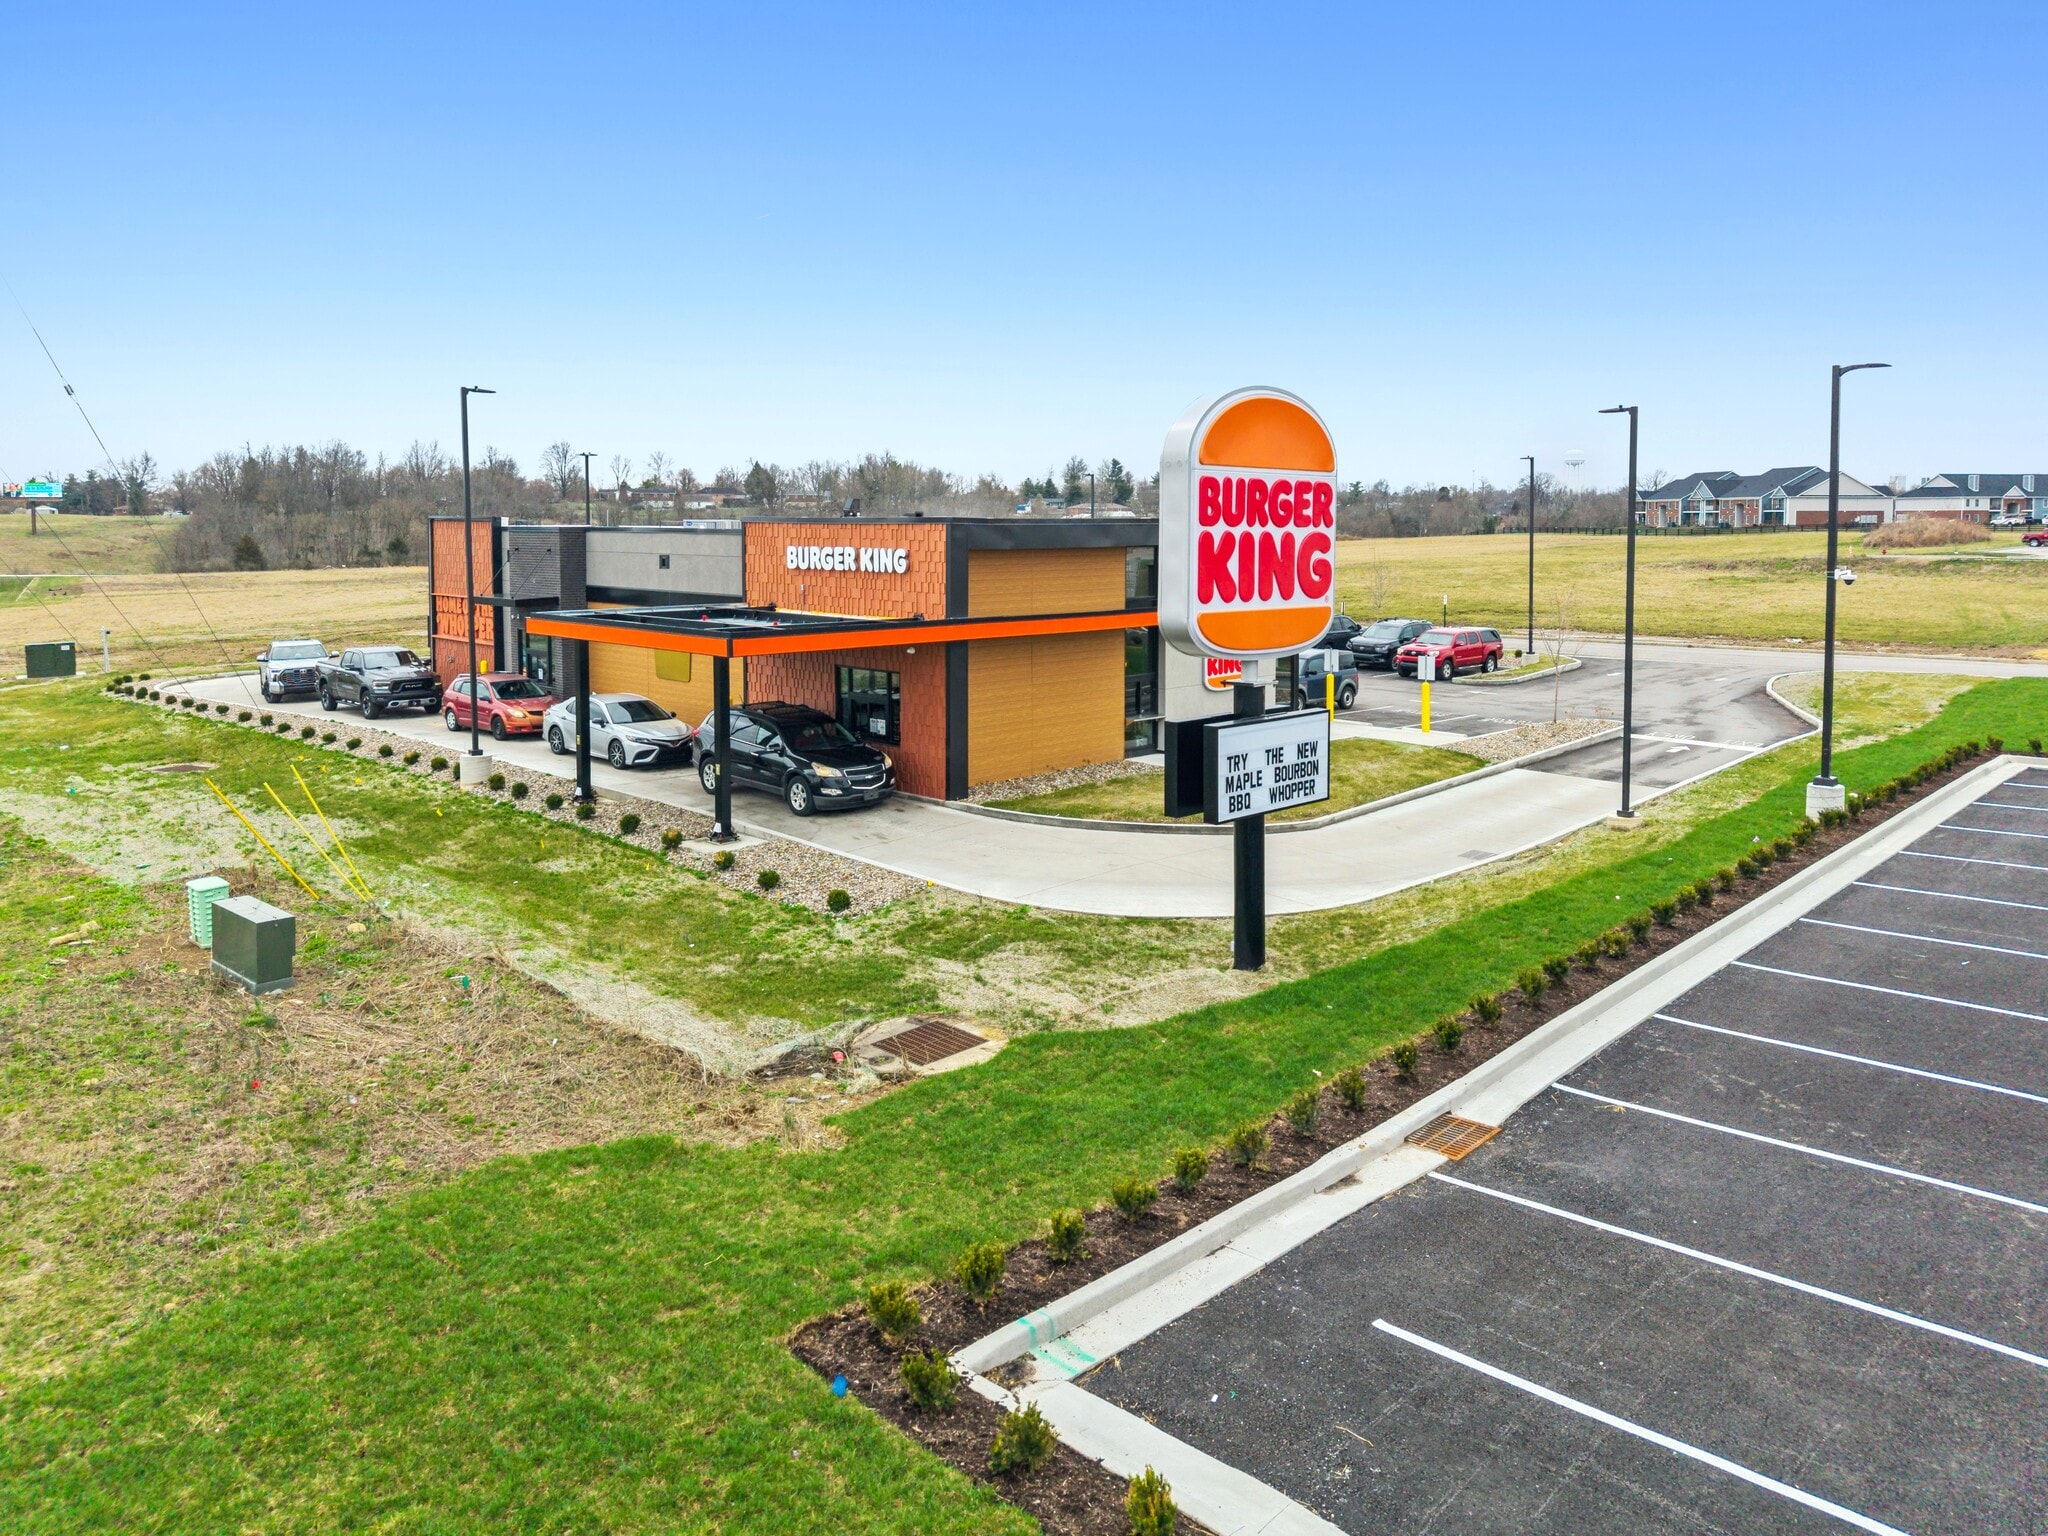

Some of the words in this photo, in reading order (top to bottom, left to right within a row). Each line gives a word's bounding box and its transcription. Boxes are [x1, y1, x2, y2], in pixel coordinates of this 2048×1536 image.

[1199, 475, 1334, 528] BURGER
[786, 546, 857, 571] BURGER
[860, 547, 908, 574] KING
[1197, 530, 1332, 604] KING
[437, 595, 462, 614] HOME
[1227, 753, 1248, 773] TRY
[1265, 747, 1284, 766] THE
[1297, 741, 1318, 760] NEW
[1225, 770, 1263, 794] MAPLE
[1274, 759, 1319, 783] BOURBON
[1229, 792, 1251, 813] BBQ
[1269, 779, 1315, 804] WHOPPER
